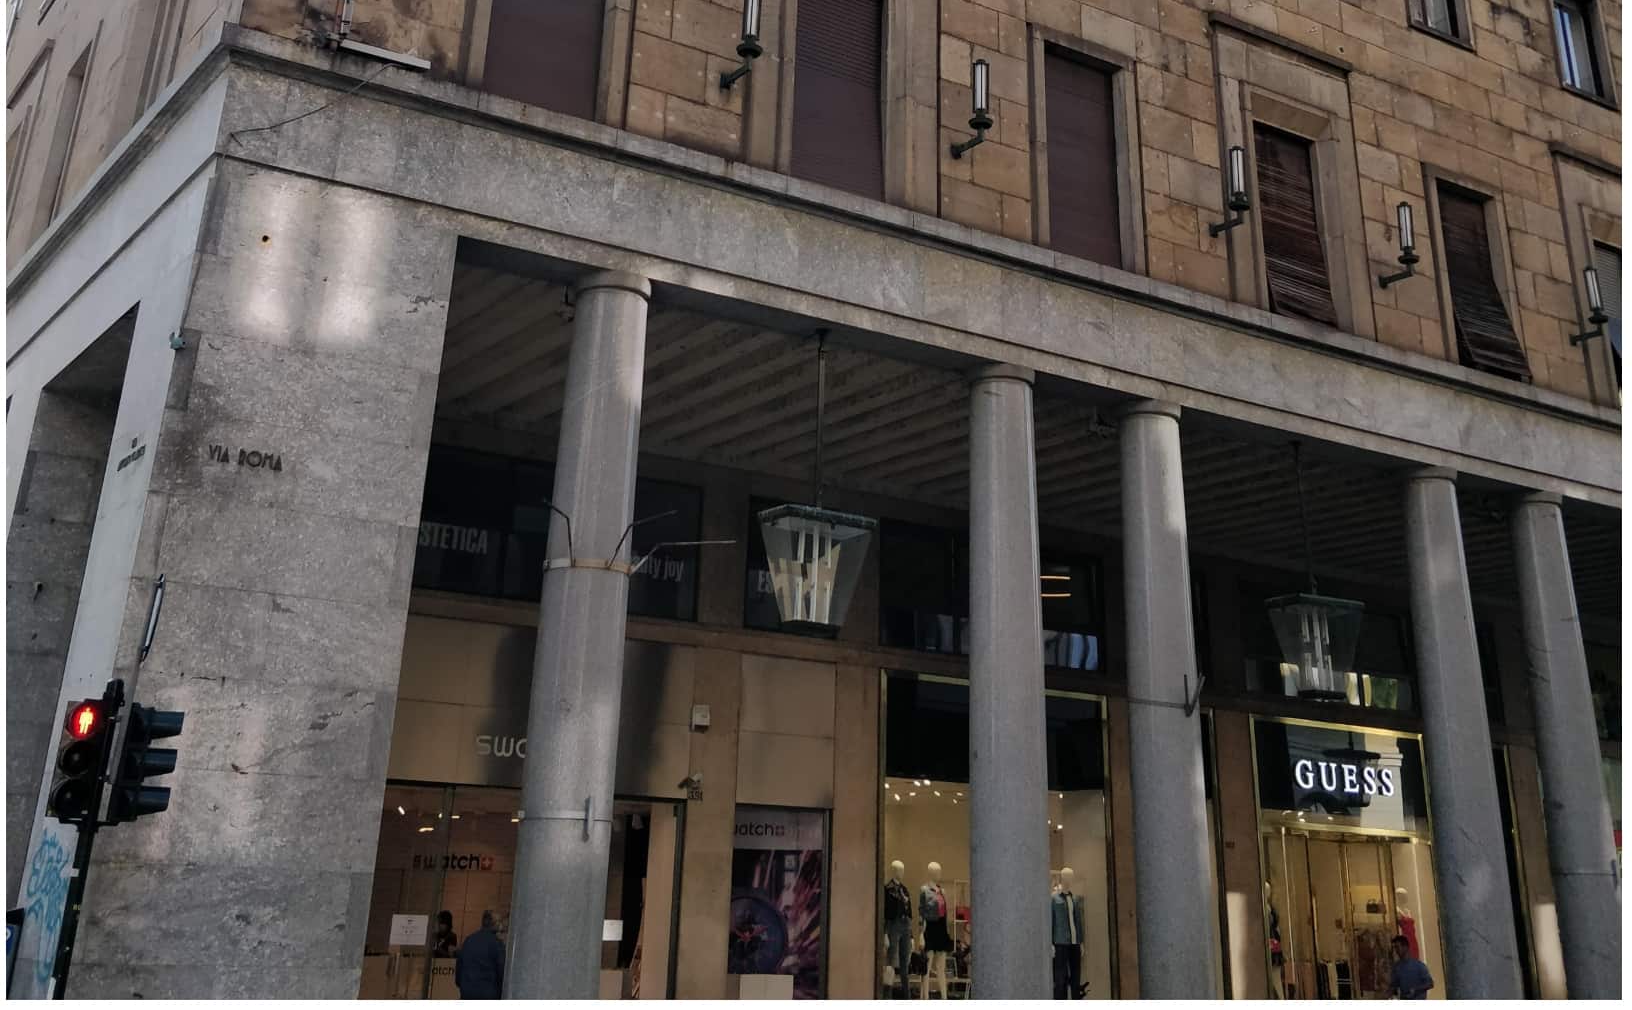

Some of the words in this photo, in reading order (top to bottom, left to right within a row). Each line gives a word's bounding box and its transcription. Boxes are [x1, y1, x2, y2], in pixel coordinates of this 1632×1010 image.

[208, 443, 230, 464] VIA
[238, 447, 283, 472] ROMA
[419, 520, 489, 555] STETICA
[1294, 758, 1394, 797] GUESS
[734, 821, 774, 837] atch
